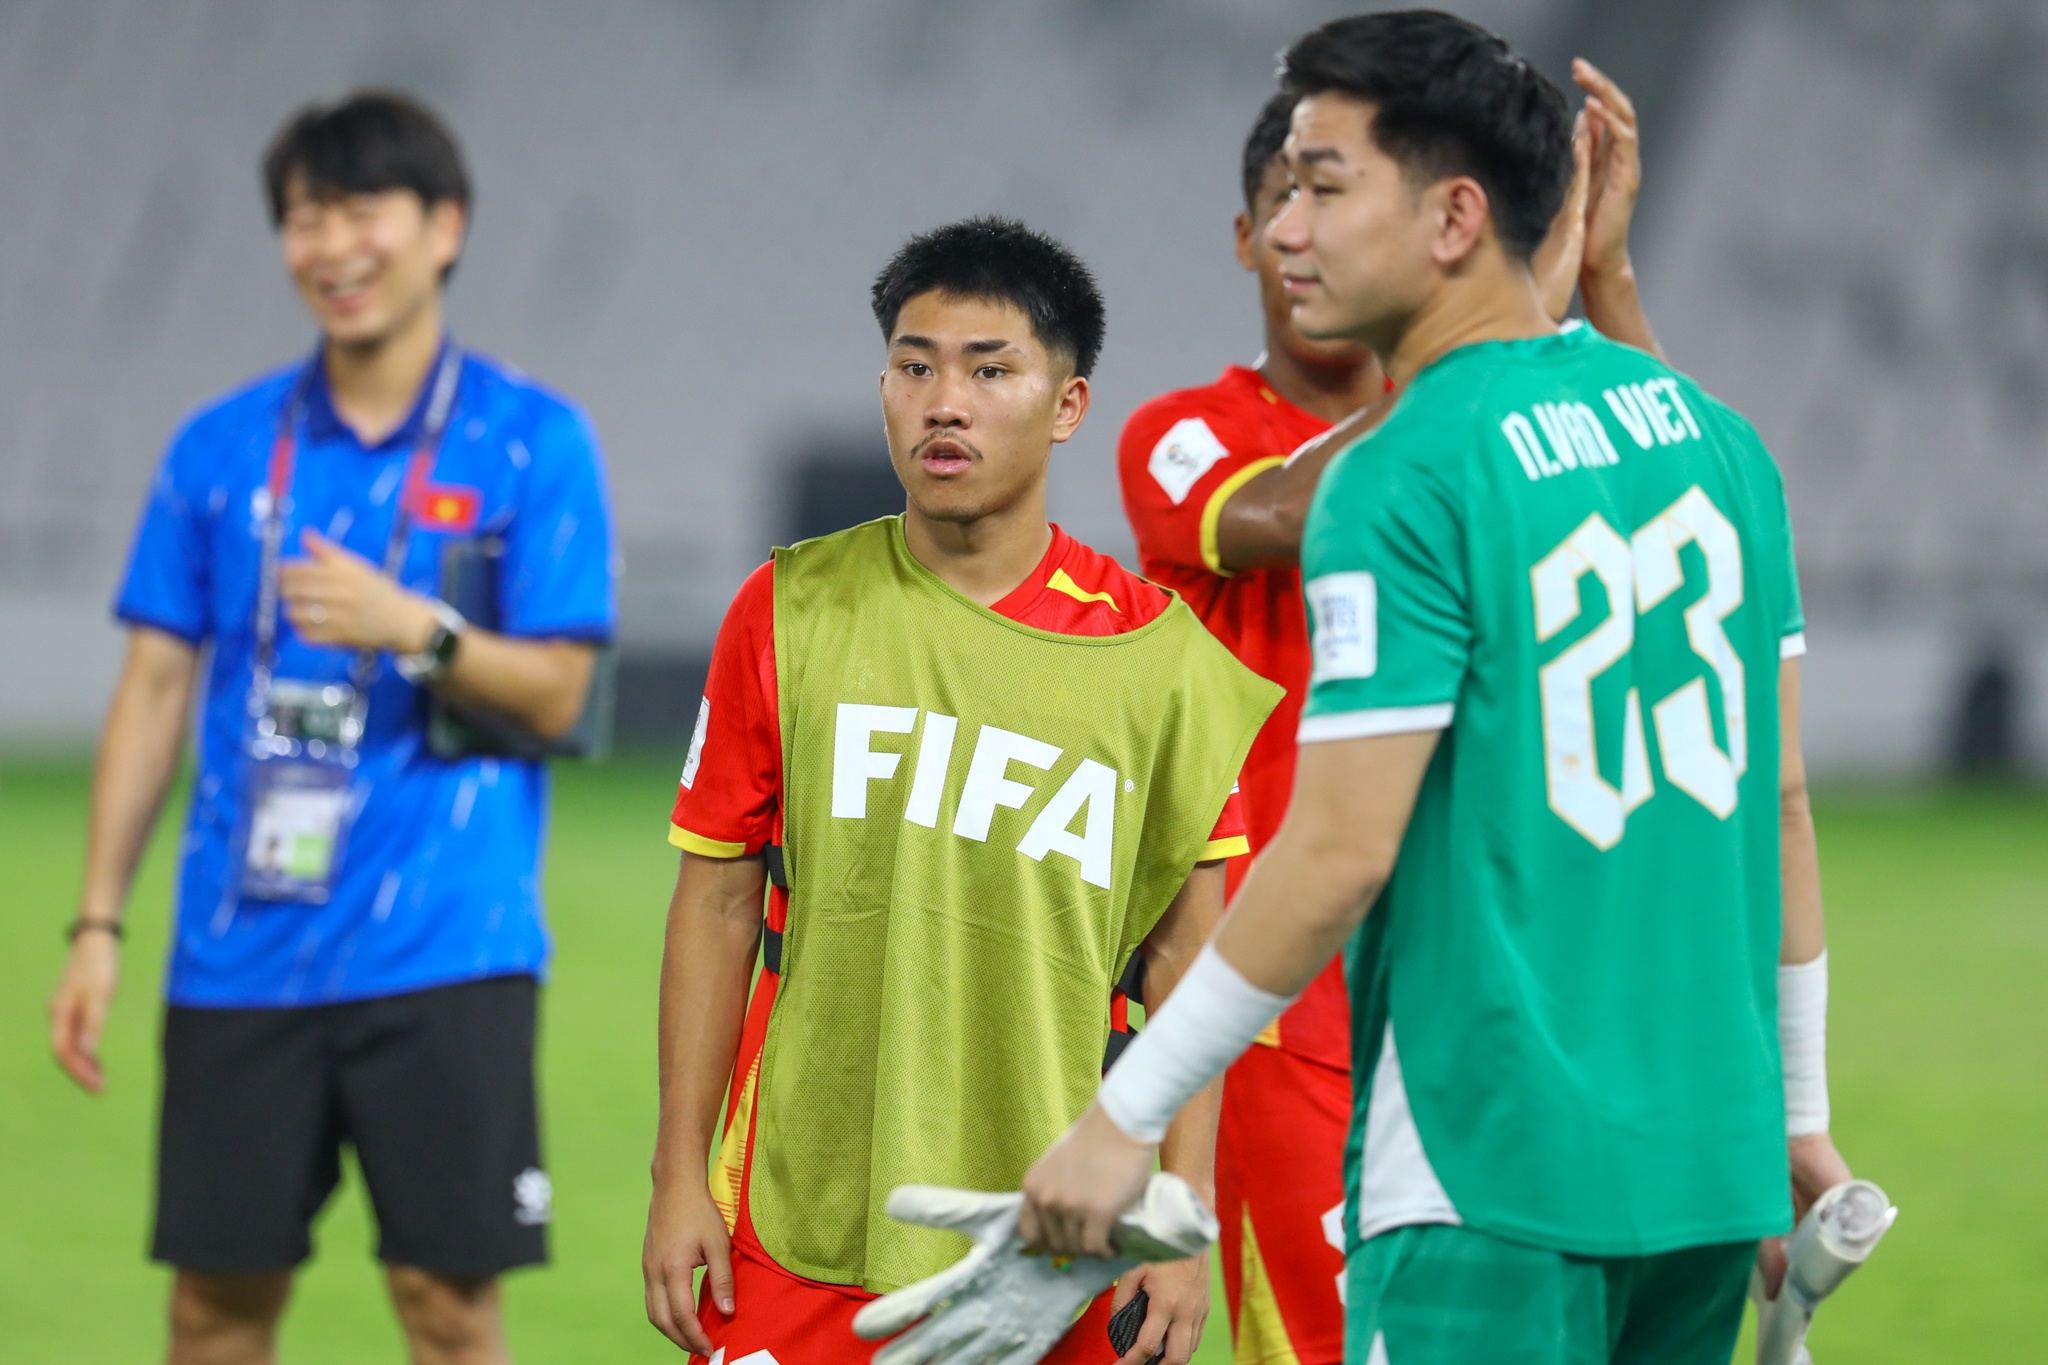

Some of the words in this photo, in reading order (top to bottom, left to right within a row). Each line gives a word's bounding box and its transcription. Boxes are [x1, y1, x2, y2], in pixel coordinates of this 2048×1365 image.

[1601, 377, 1701, 450] VIET
[1530, 484, 1747, 851] 23
[831, 703, 1117, 890] FIFA
